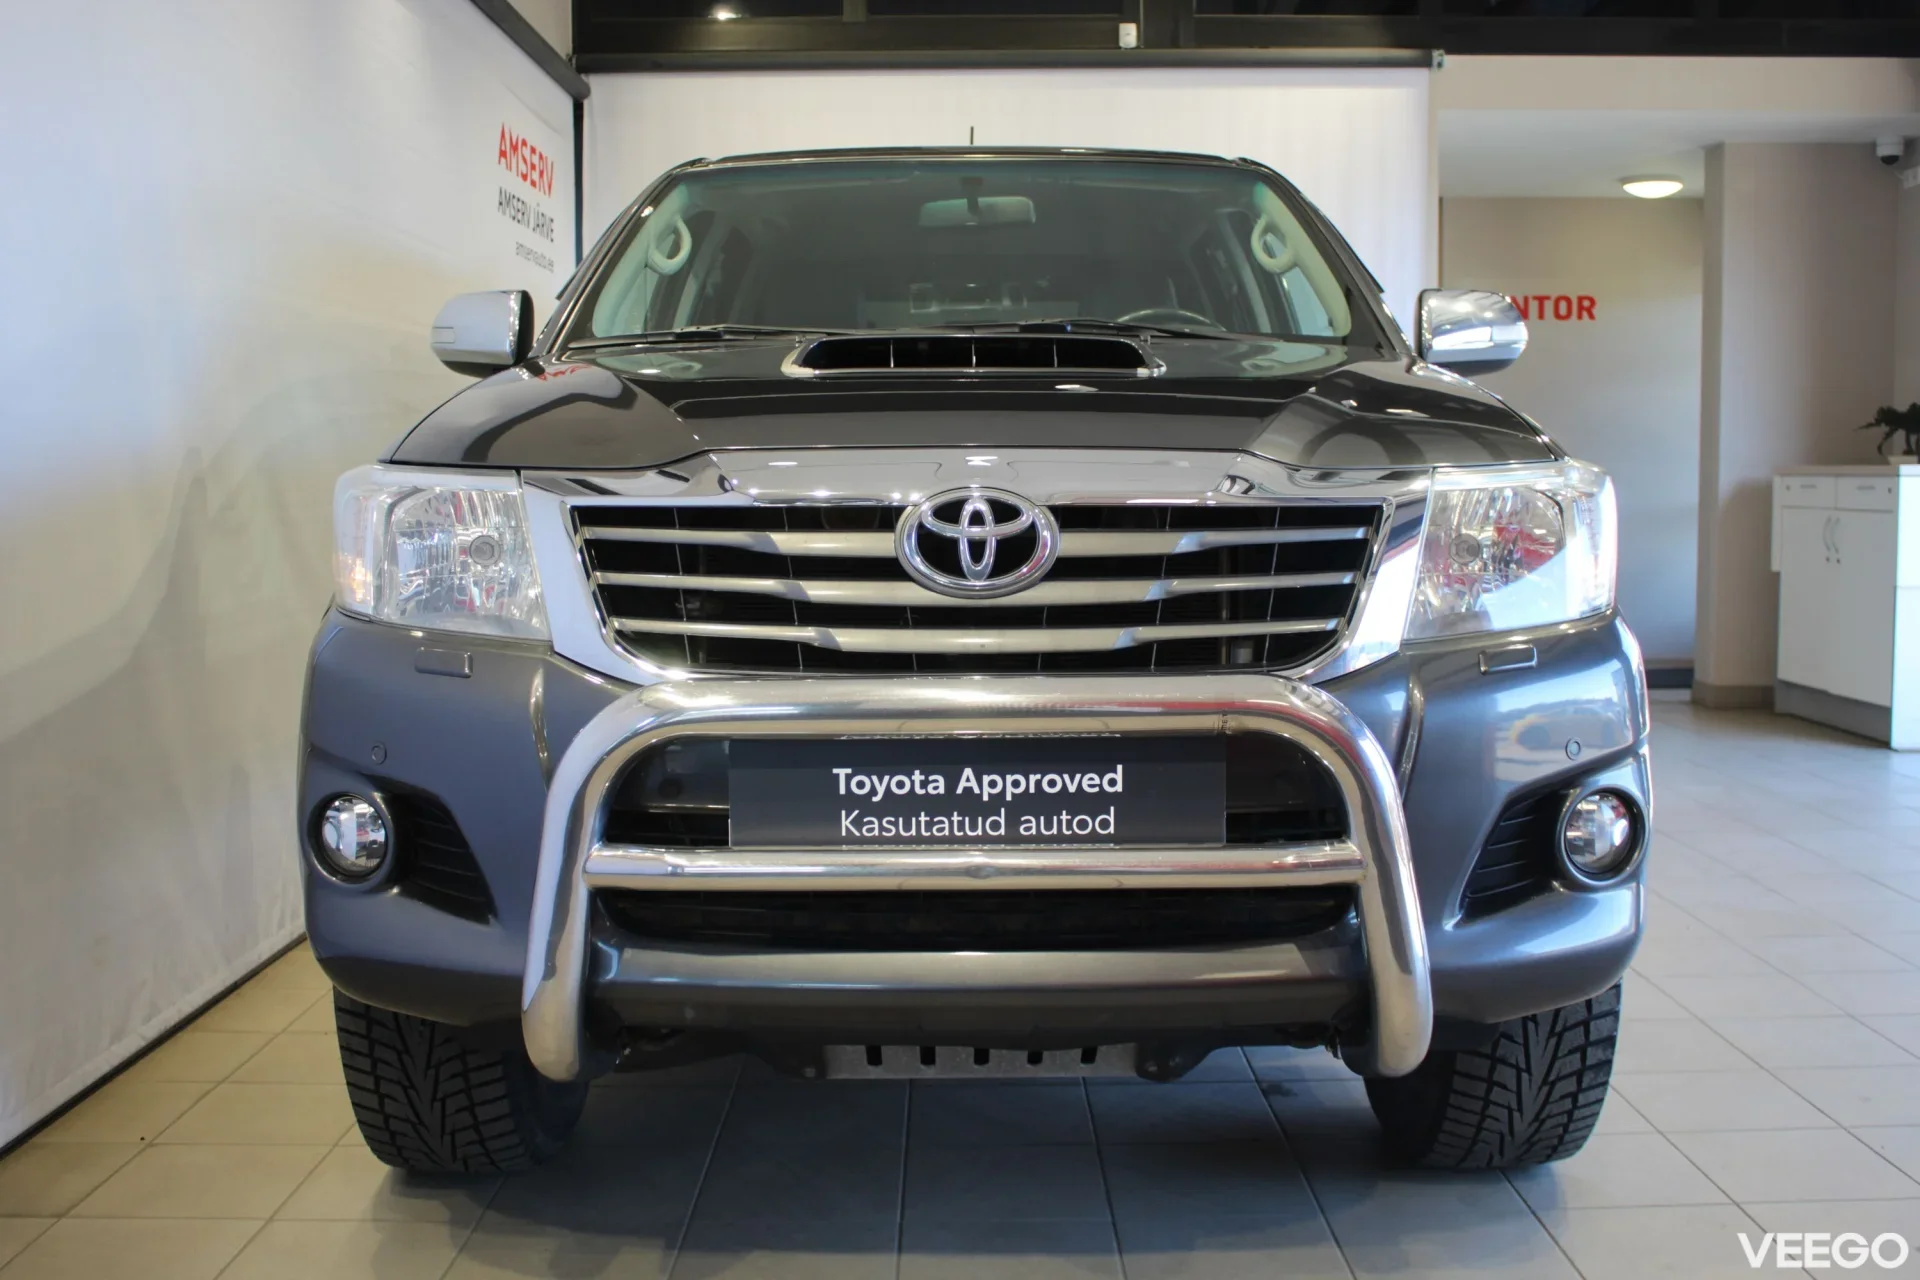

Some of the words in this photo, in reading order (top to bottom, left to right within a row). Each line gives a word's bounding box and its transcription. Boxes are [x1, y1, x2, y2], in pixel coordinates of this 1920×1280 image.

[498, 122, 554, 197] AMSERV
[498, 186, 532, 229] AMSERV
[532, 202, 554, 242] JÄRVE
[832, 767, 945, 802] Toyota
[956, 764, 1124, 801] Approved
[840, 808, 1006, 837] Kasutatud
[1019, 806, 1115, 836] autod
